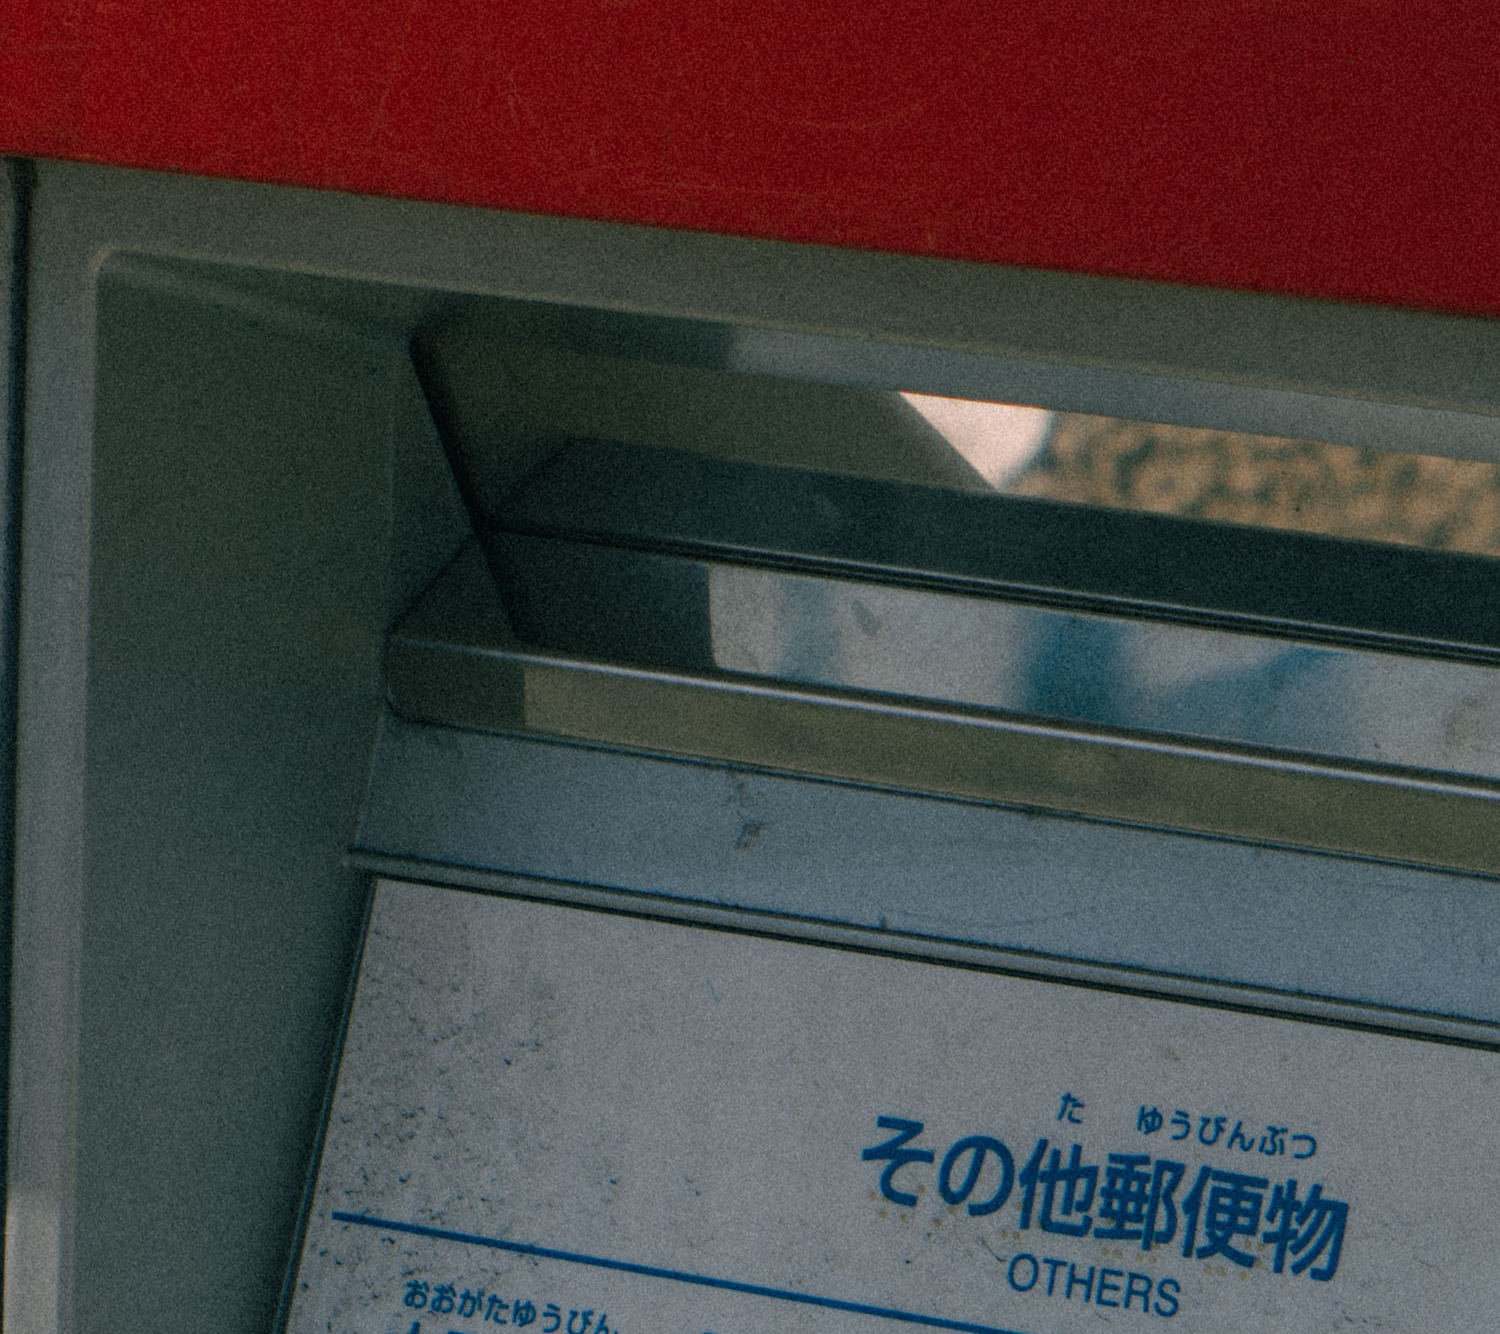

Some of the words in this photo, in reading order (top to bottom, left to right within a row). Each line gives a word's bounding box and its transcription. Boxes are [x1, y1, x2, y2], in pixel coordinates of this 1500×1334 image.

[1056, 1091, 1085, 1125] た
[1135, 1104, 1319, 1161] ゆうびんぶつ
[860, 1113, 1351, 1284] その他郵便物
[1006, 1251, 1182, 1319] OTHERS
